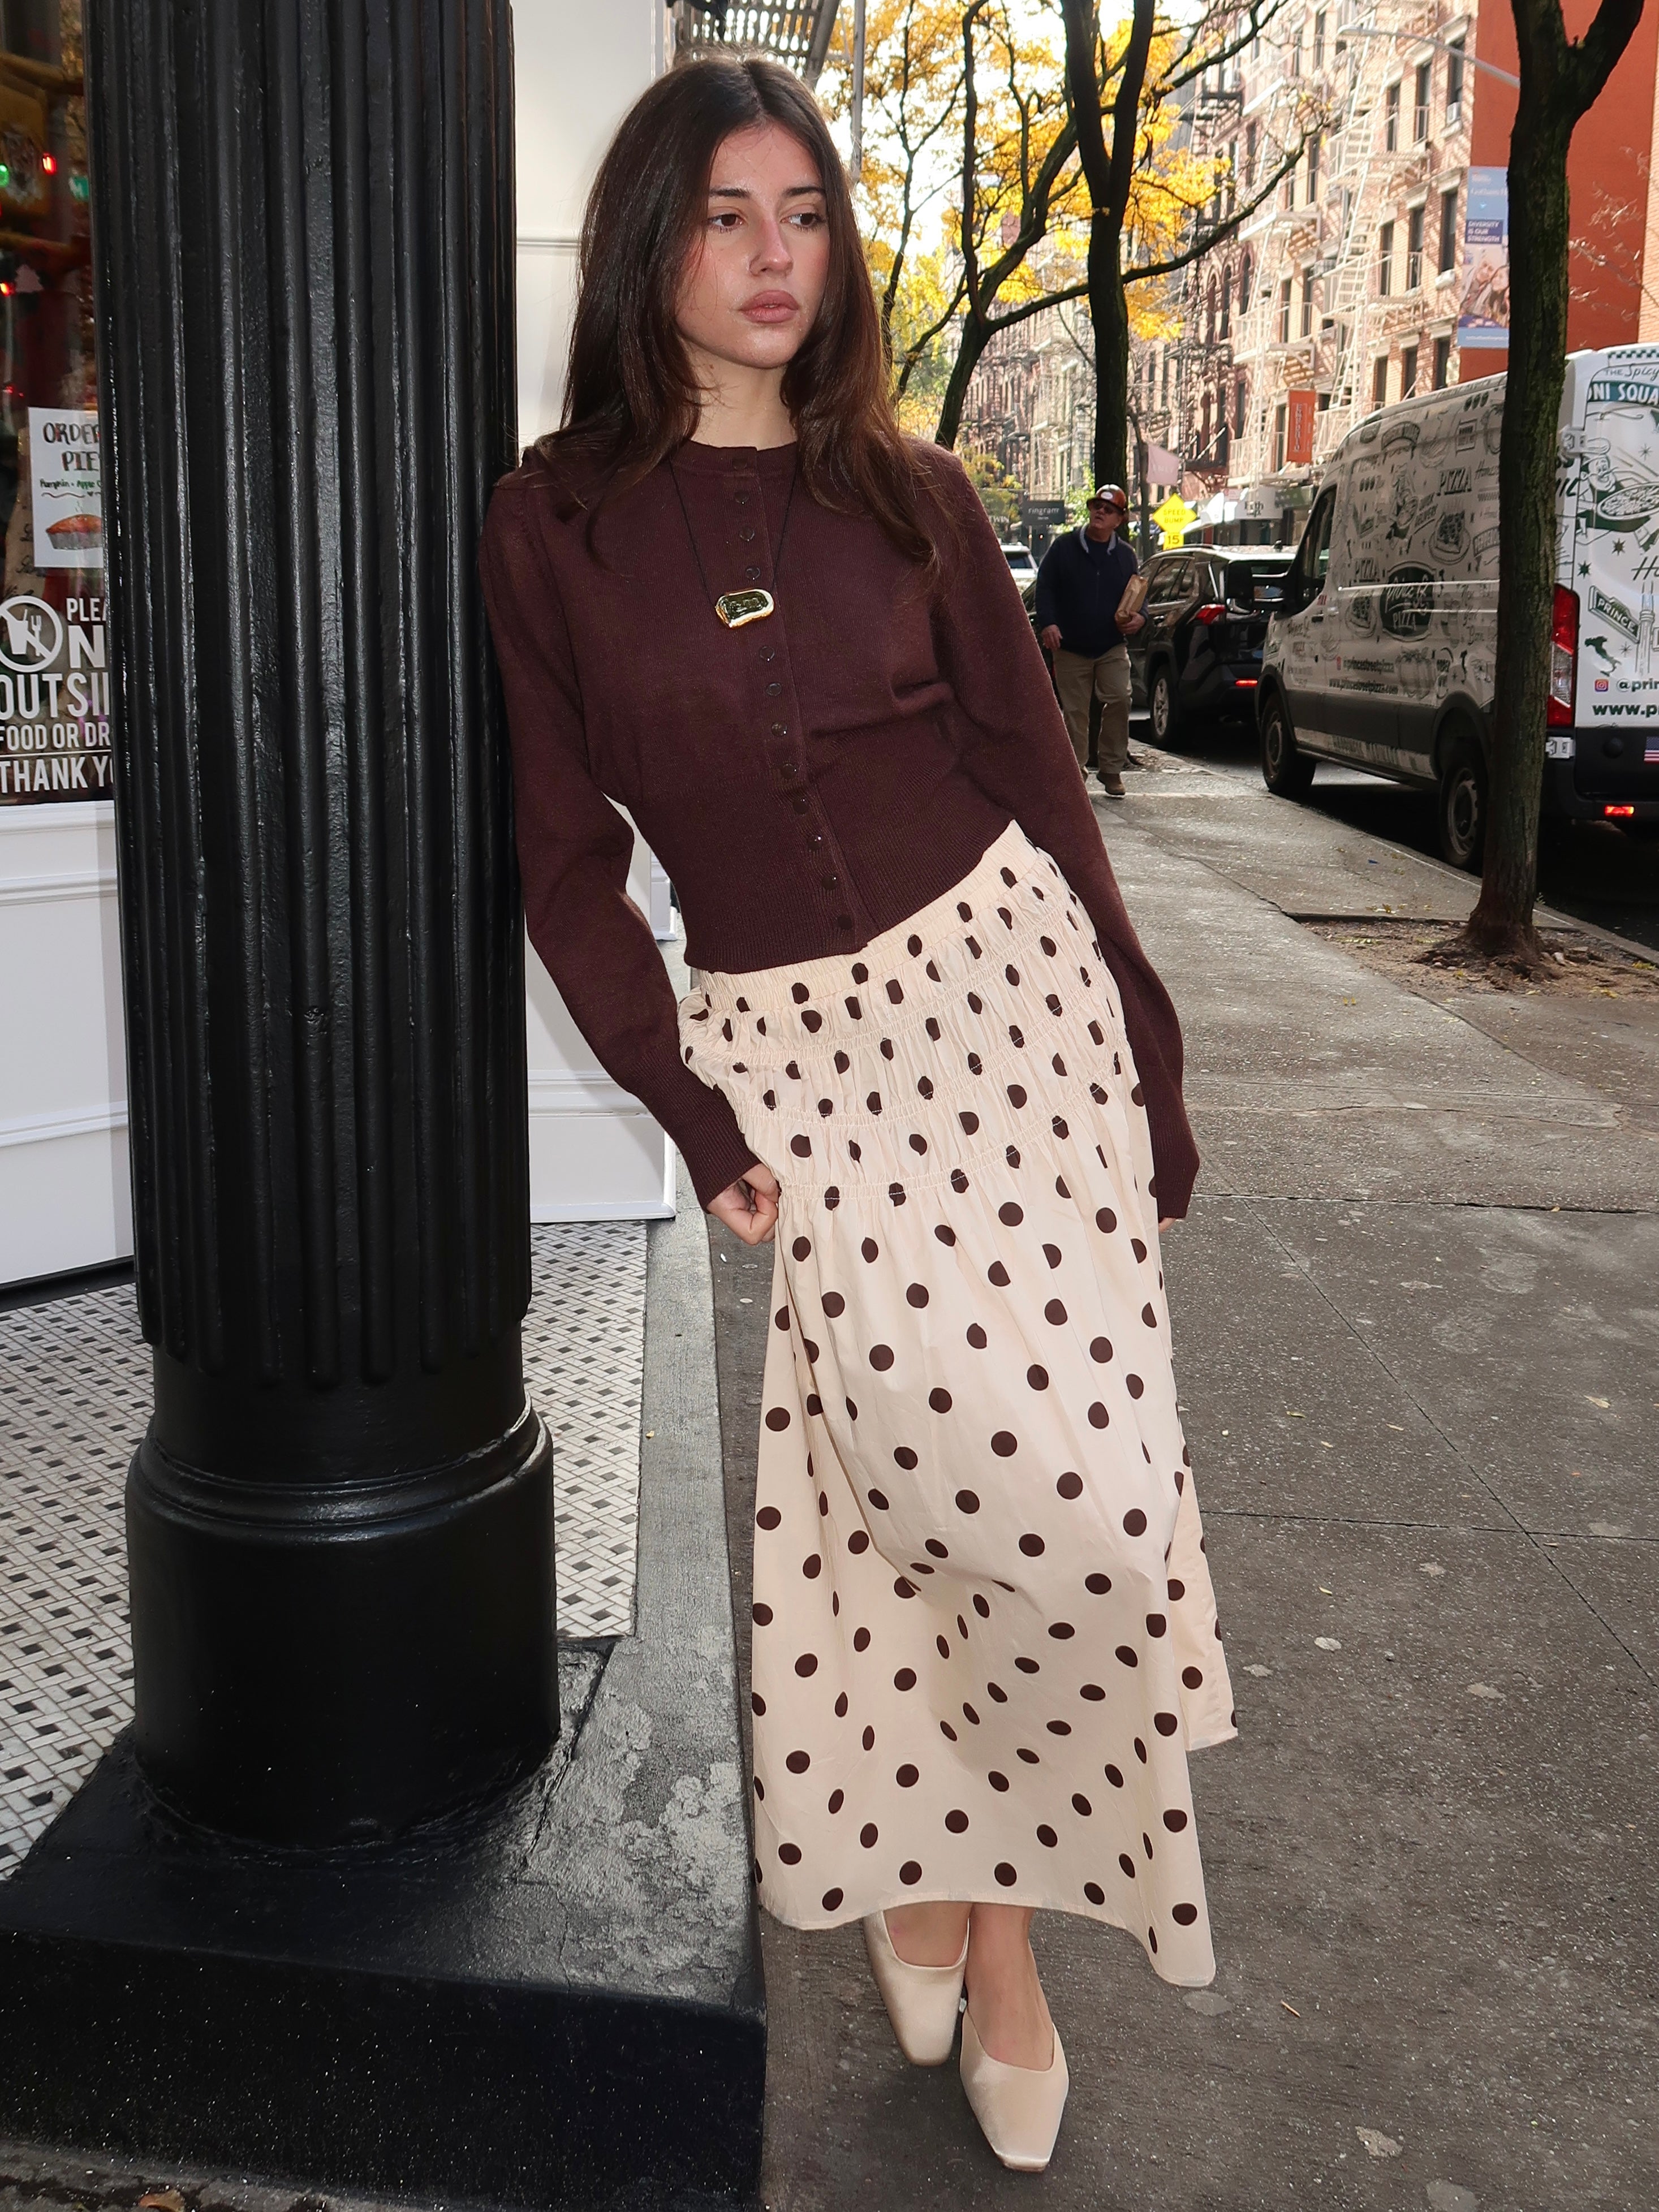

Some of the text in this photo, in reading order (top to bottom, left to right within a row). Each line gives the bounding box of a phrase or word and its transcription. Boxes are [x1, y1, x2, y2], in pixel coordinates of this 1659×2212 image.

[1625, 364, 1659, 381] Spicy
[40, 478, 70, 490] Pumpkin
[1436, 466, 1472, 496] PIZZA
[1168, 535, 1179, 544] 15
[1354, 557, 1380, 583] PIZZA
[1392, 611, 1416, 630] PIZZA
[1597, 598, 1636, 633] PRINCE
[68, 625, 105, 668] N
[1592, 705, 1659, 718] www.p
[53, 723, 80, 748] OR
[85, 721, 111, 747] DR
[0, 756, 113, 794] THANK Y
